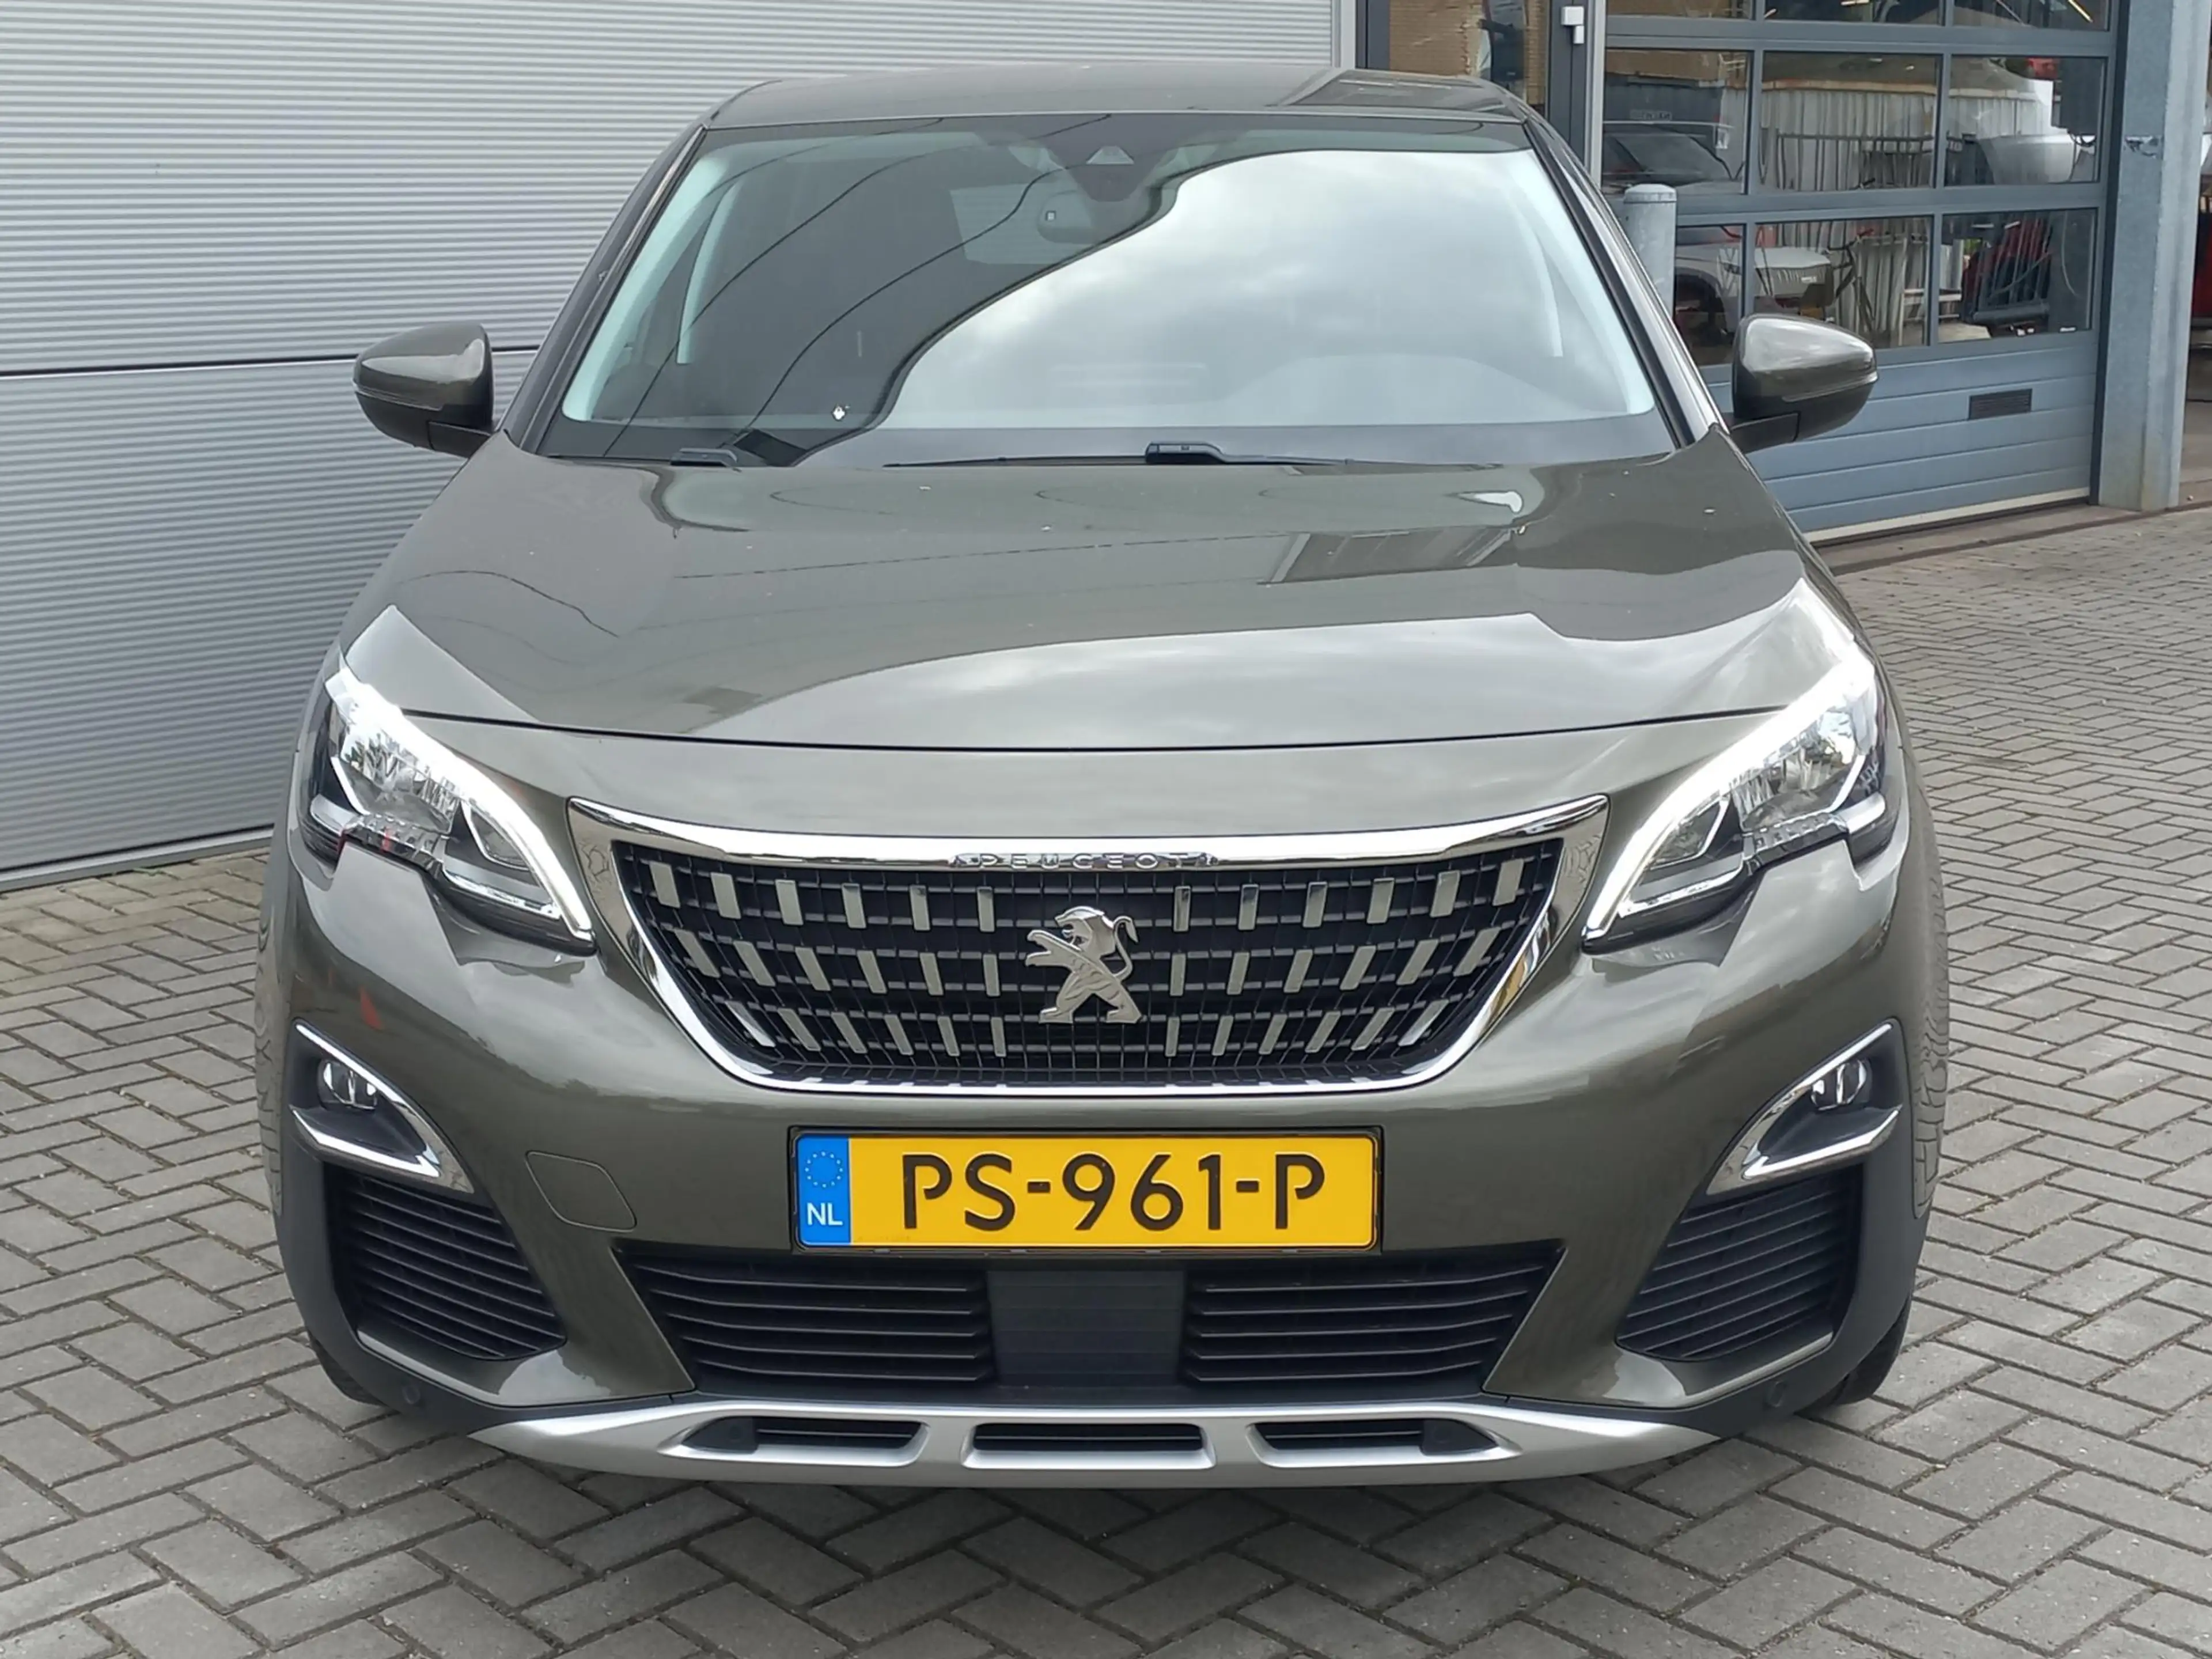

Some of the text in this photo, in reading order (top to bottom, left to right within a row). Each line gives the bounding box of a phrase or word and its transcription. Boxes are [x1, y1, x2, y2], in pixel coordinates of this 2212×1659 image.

[979, 853, 1188, 869] PEUGEOT
[902, 1152, 1325, 1231] PS-961-P
[807, 1203, 843, 1227] NL
